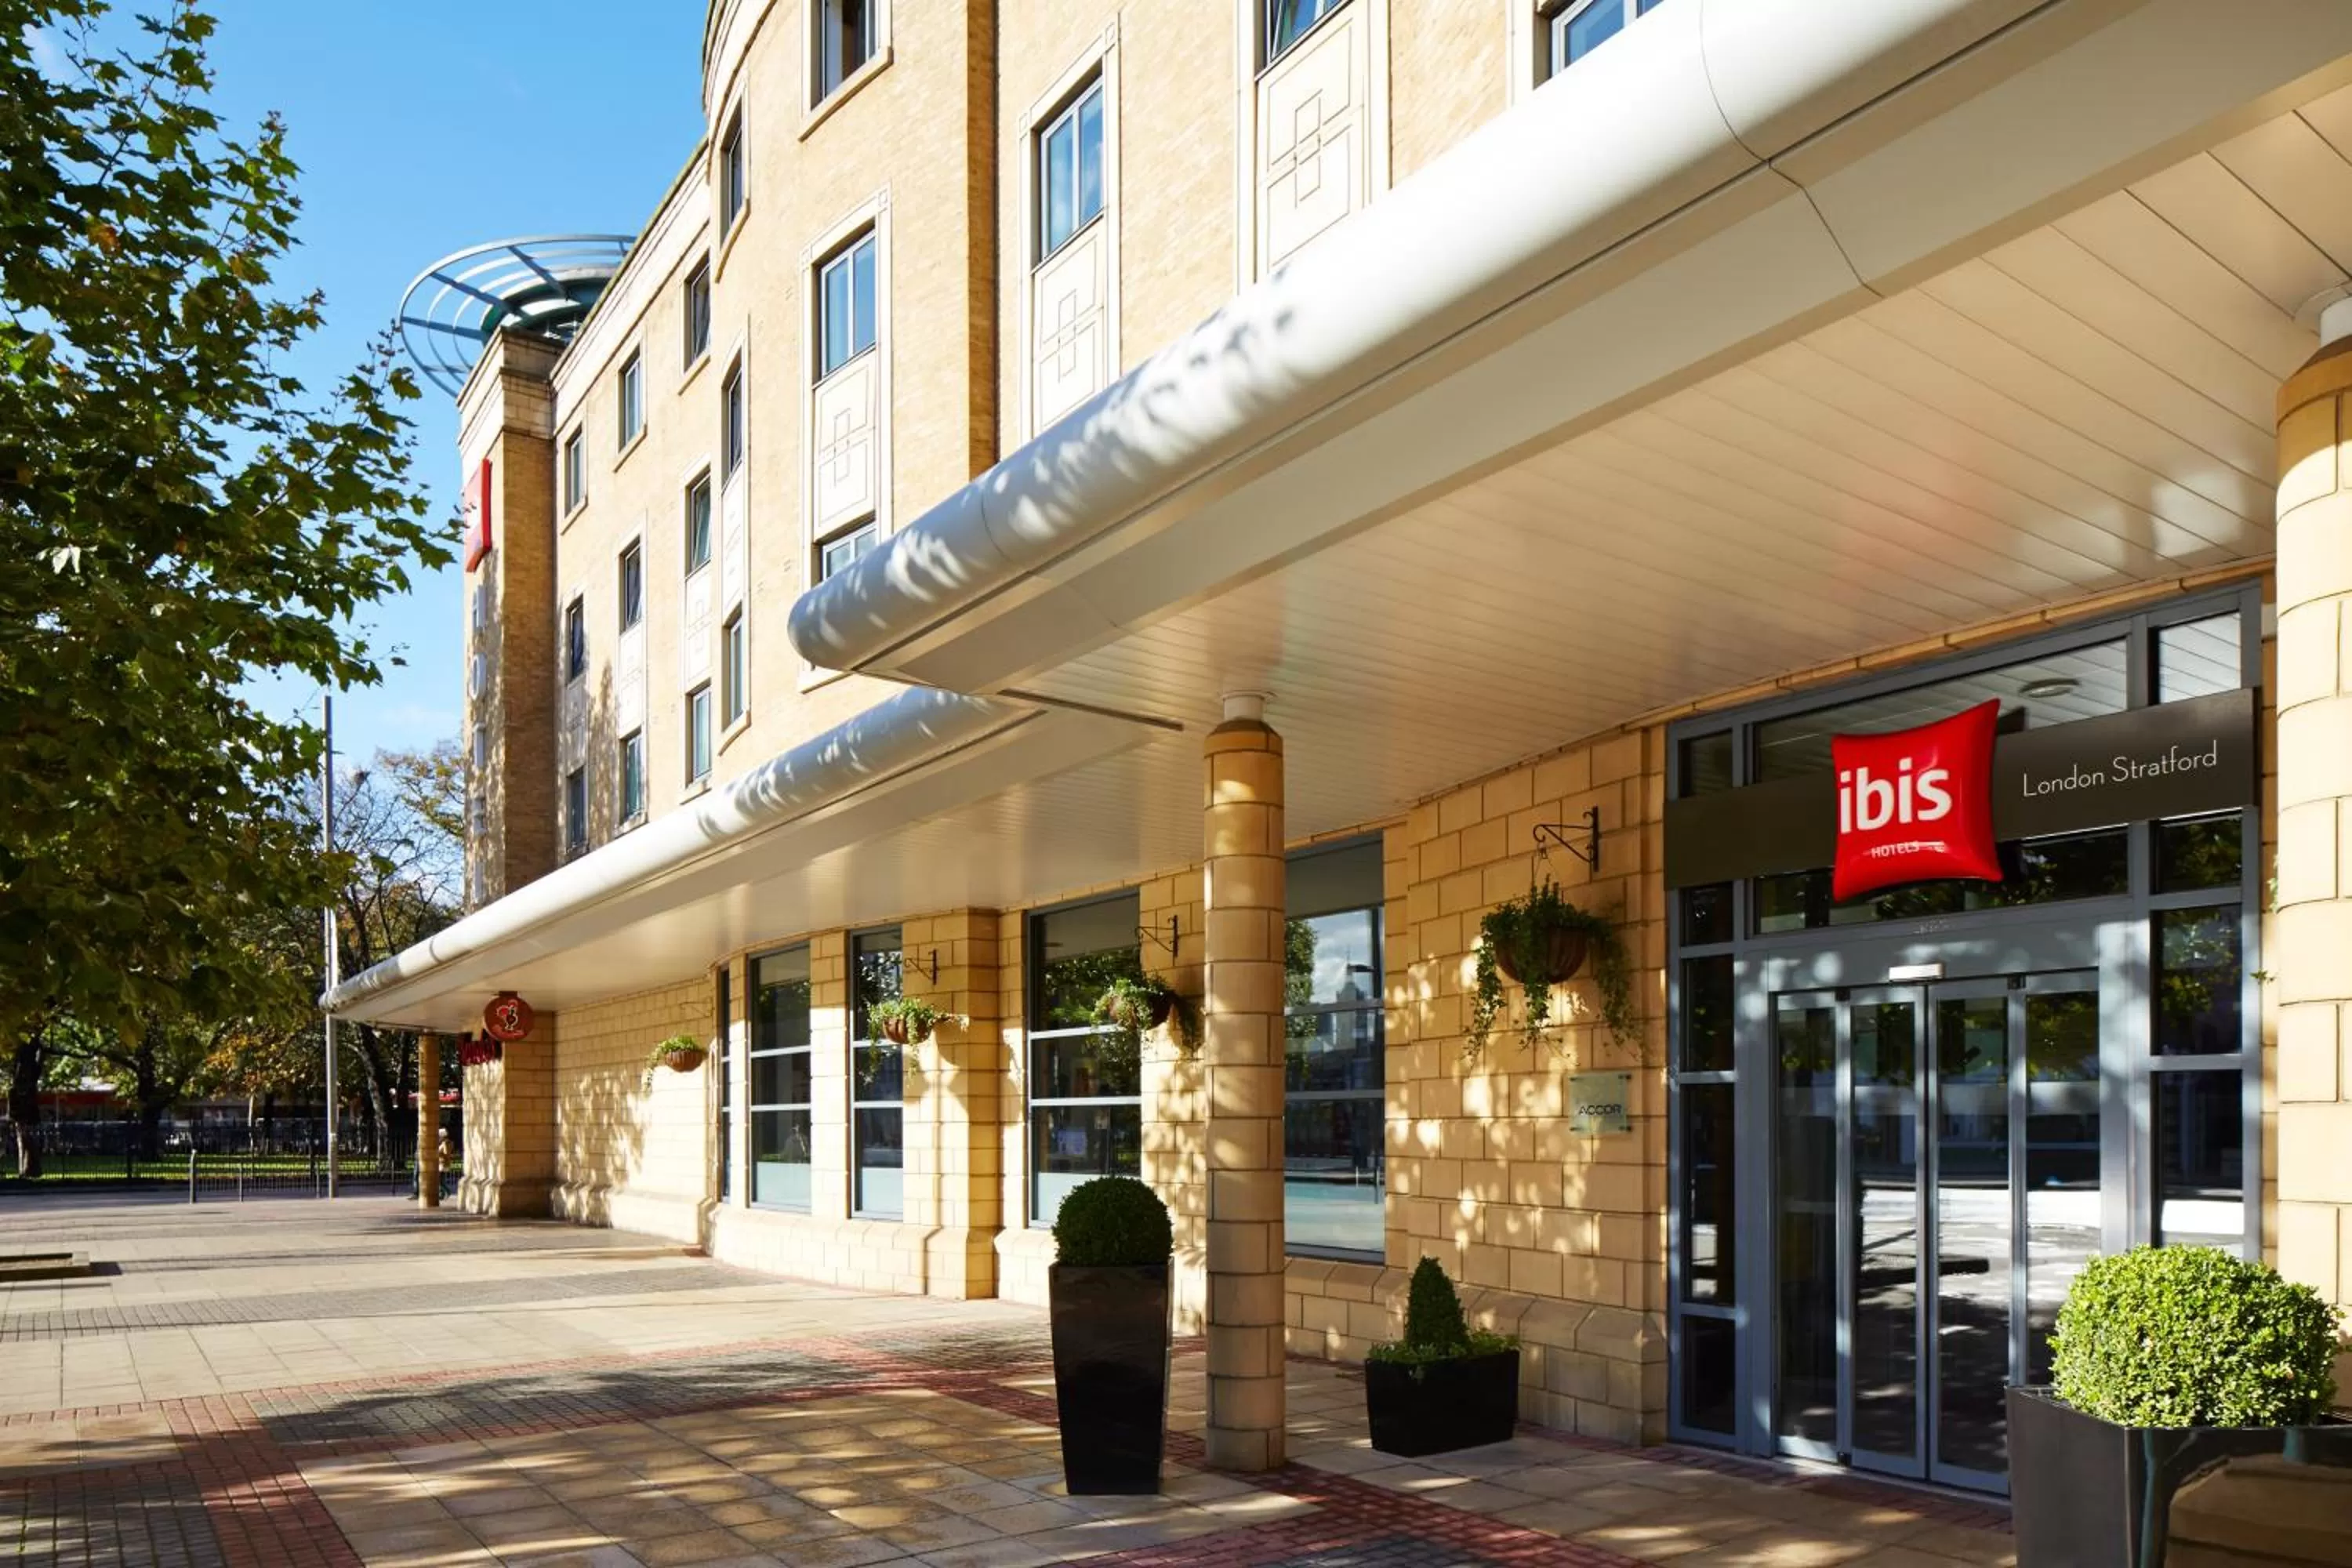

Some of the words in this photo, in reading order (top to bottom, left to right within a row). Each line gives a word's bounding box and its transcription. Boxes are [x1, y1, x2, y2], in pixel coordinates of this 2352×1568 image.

[2023, 763, 2105, 797] London
[2111, 739, 2217, 782] Stratford
[1840, 757, 1953, 835] ibis
[1871, 840, 1920, 858] HOTELS
[1578, 1104, 1622, 1116] ACCOR
